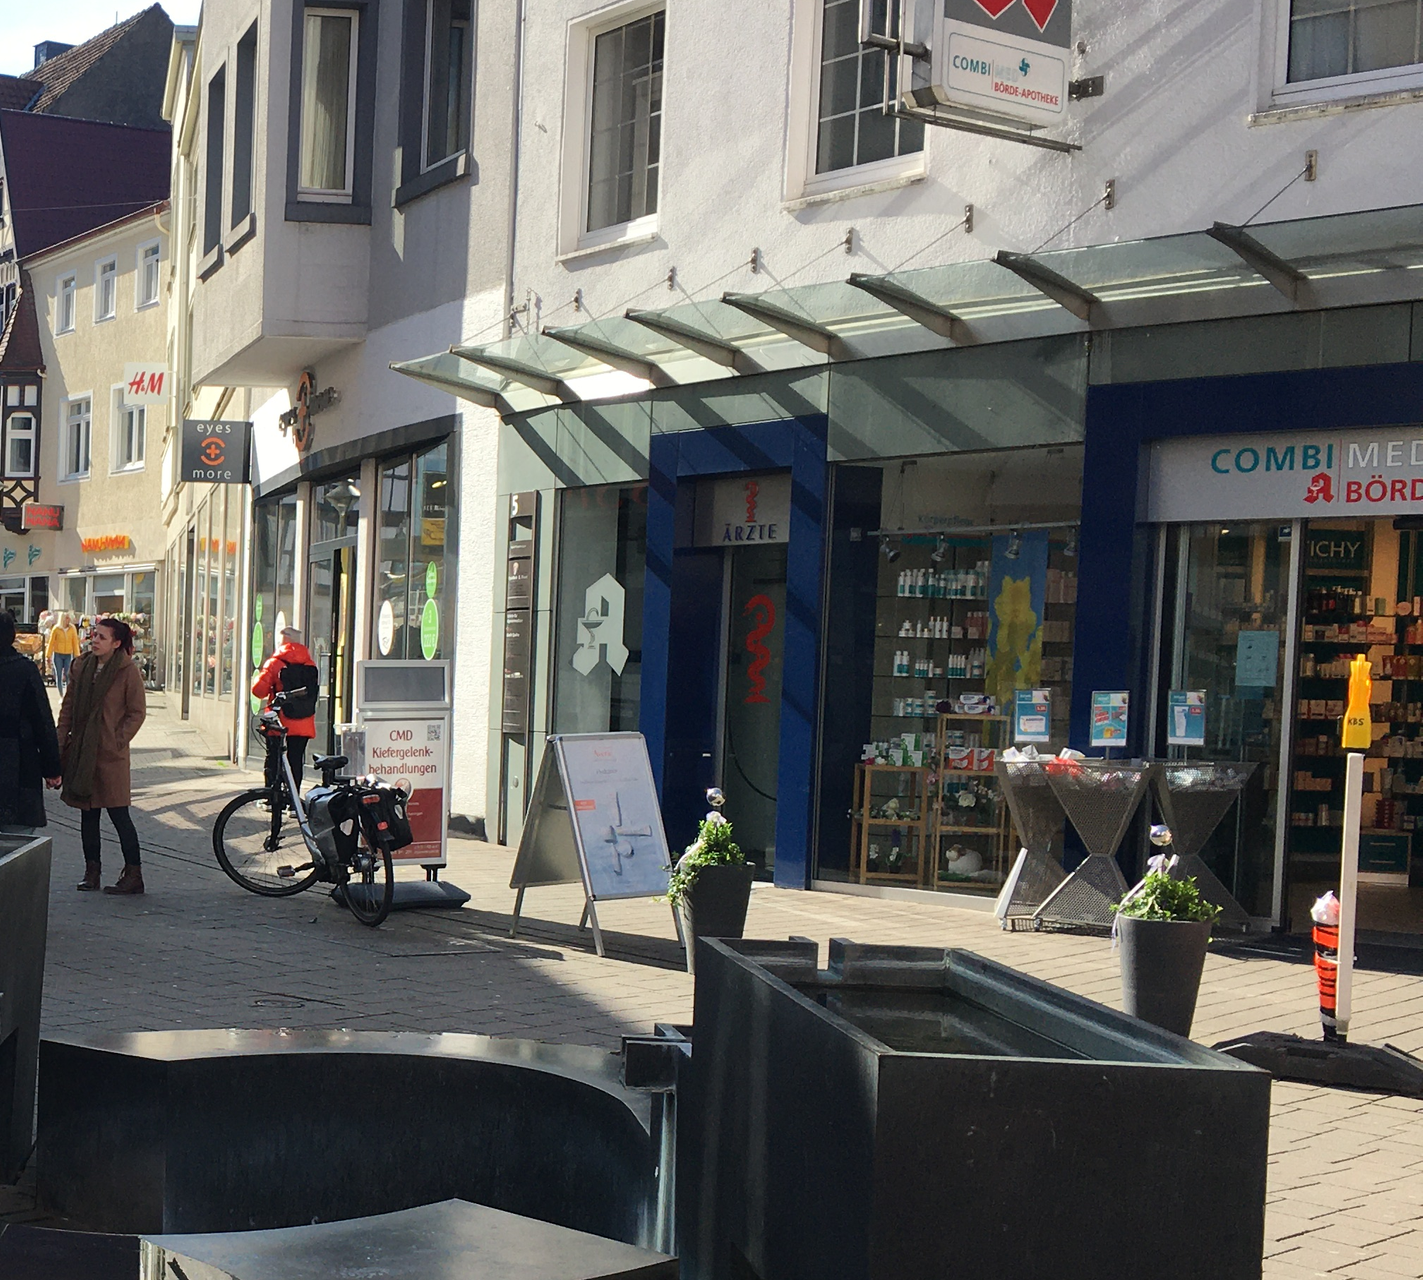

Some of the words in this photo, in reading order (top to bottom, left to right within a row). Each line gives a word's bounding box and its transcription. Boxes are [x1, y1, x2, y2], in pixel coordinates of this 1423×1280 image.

[953, 55, 991, 76] COMBI
[994, 81, 1059, 106] BÖRDE-APOTHEKE
[128, 371, 165, 396] H&M
[196, 423, 232, 436] eyes
[1210, 443, 1334, 474] COMBI
[192, 469, 232, 480] more
[26, 506, 60, 517] NANU
[512, 494, 519, 516] 5
[723, 523, 777, 542] ÄRZTE
[1307, 540, 1361, 558] ICHY
[1347, 717, 1364, 726] KBS
[389, 729, 413, 741] CMD
[372, 746, 434, 760] Kiefergelenk-
[368, 763, 437, 776] behandlungen
